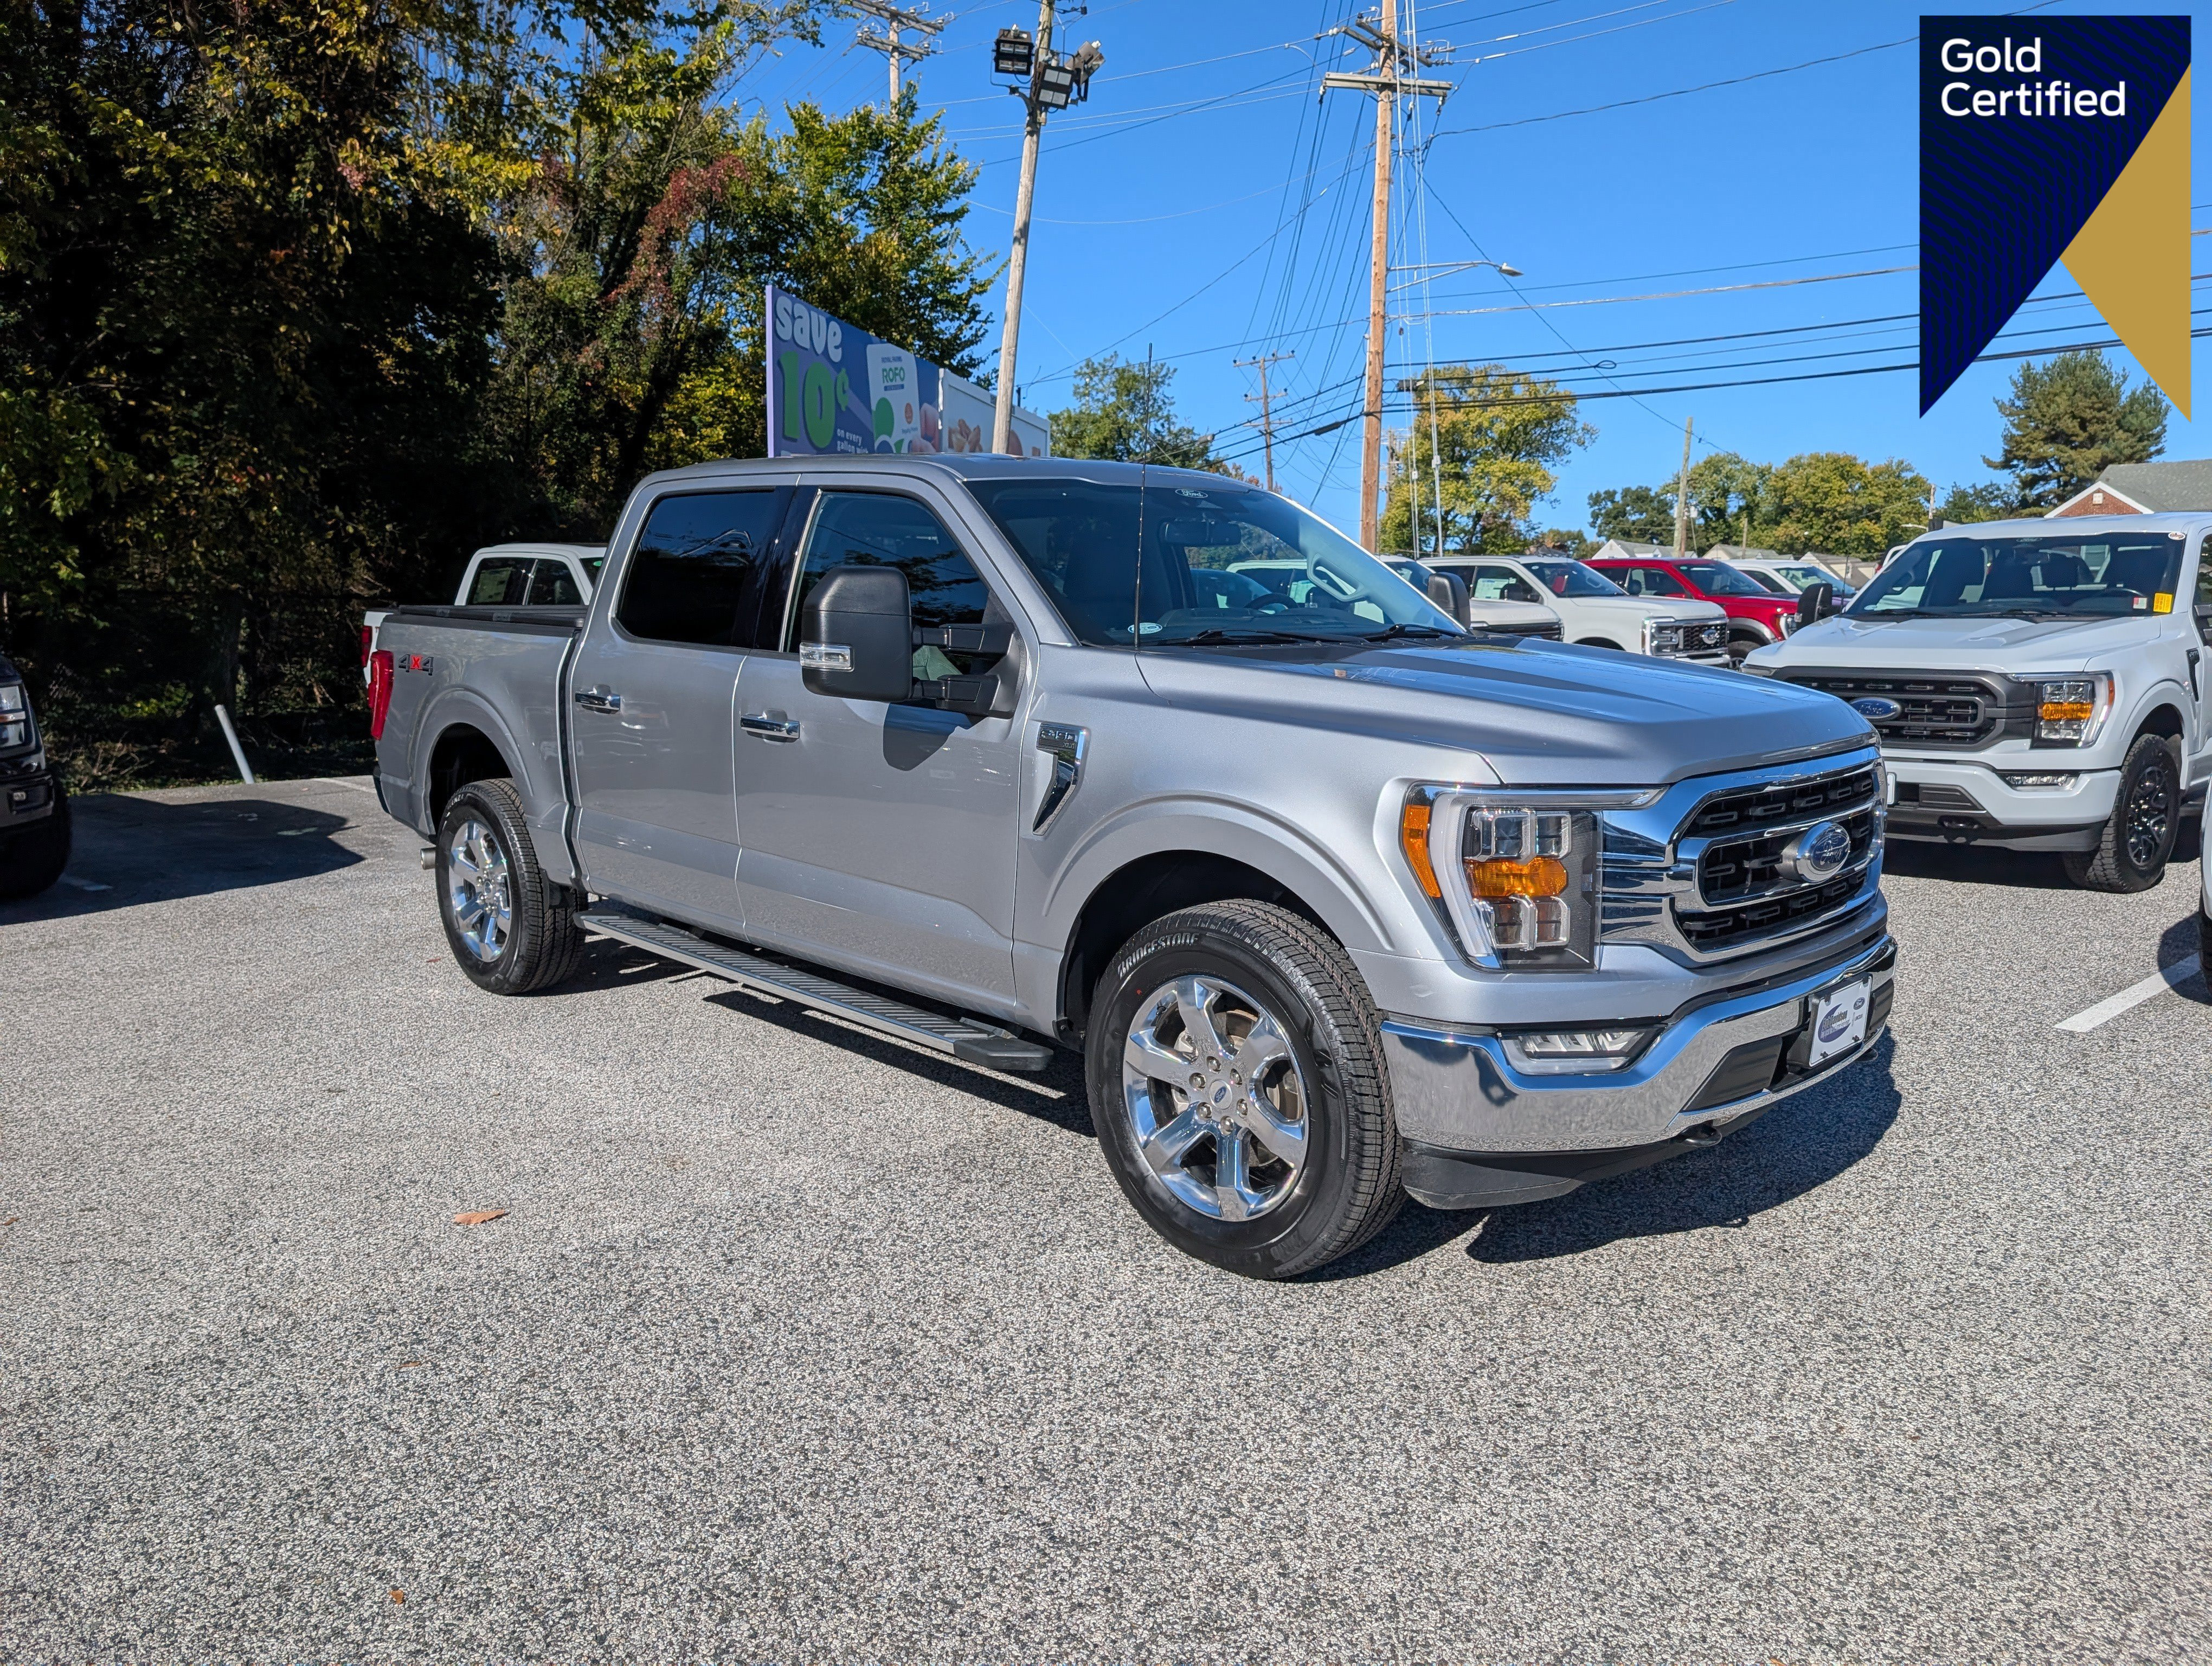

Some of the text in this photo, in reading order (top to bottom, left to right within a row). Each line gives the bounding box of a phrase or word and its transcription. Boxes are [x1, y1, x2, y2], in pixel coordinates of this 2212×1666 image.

[776, 296, 842, 363] save
[882, 367, 905, 383] ROFO
[837, 428, 862, 446] on every
[1117, 932, 1200, 979] BRIDGESTONE
[1216, 1088, 1225, 1101] Ford
